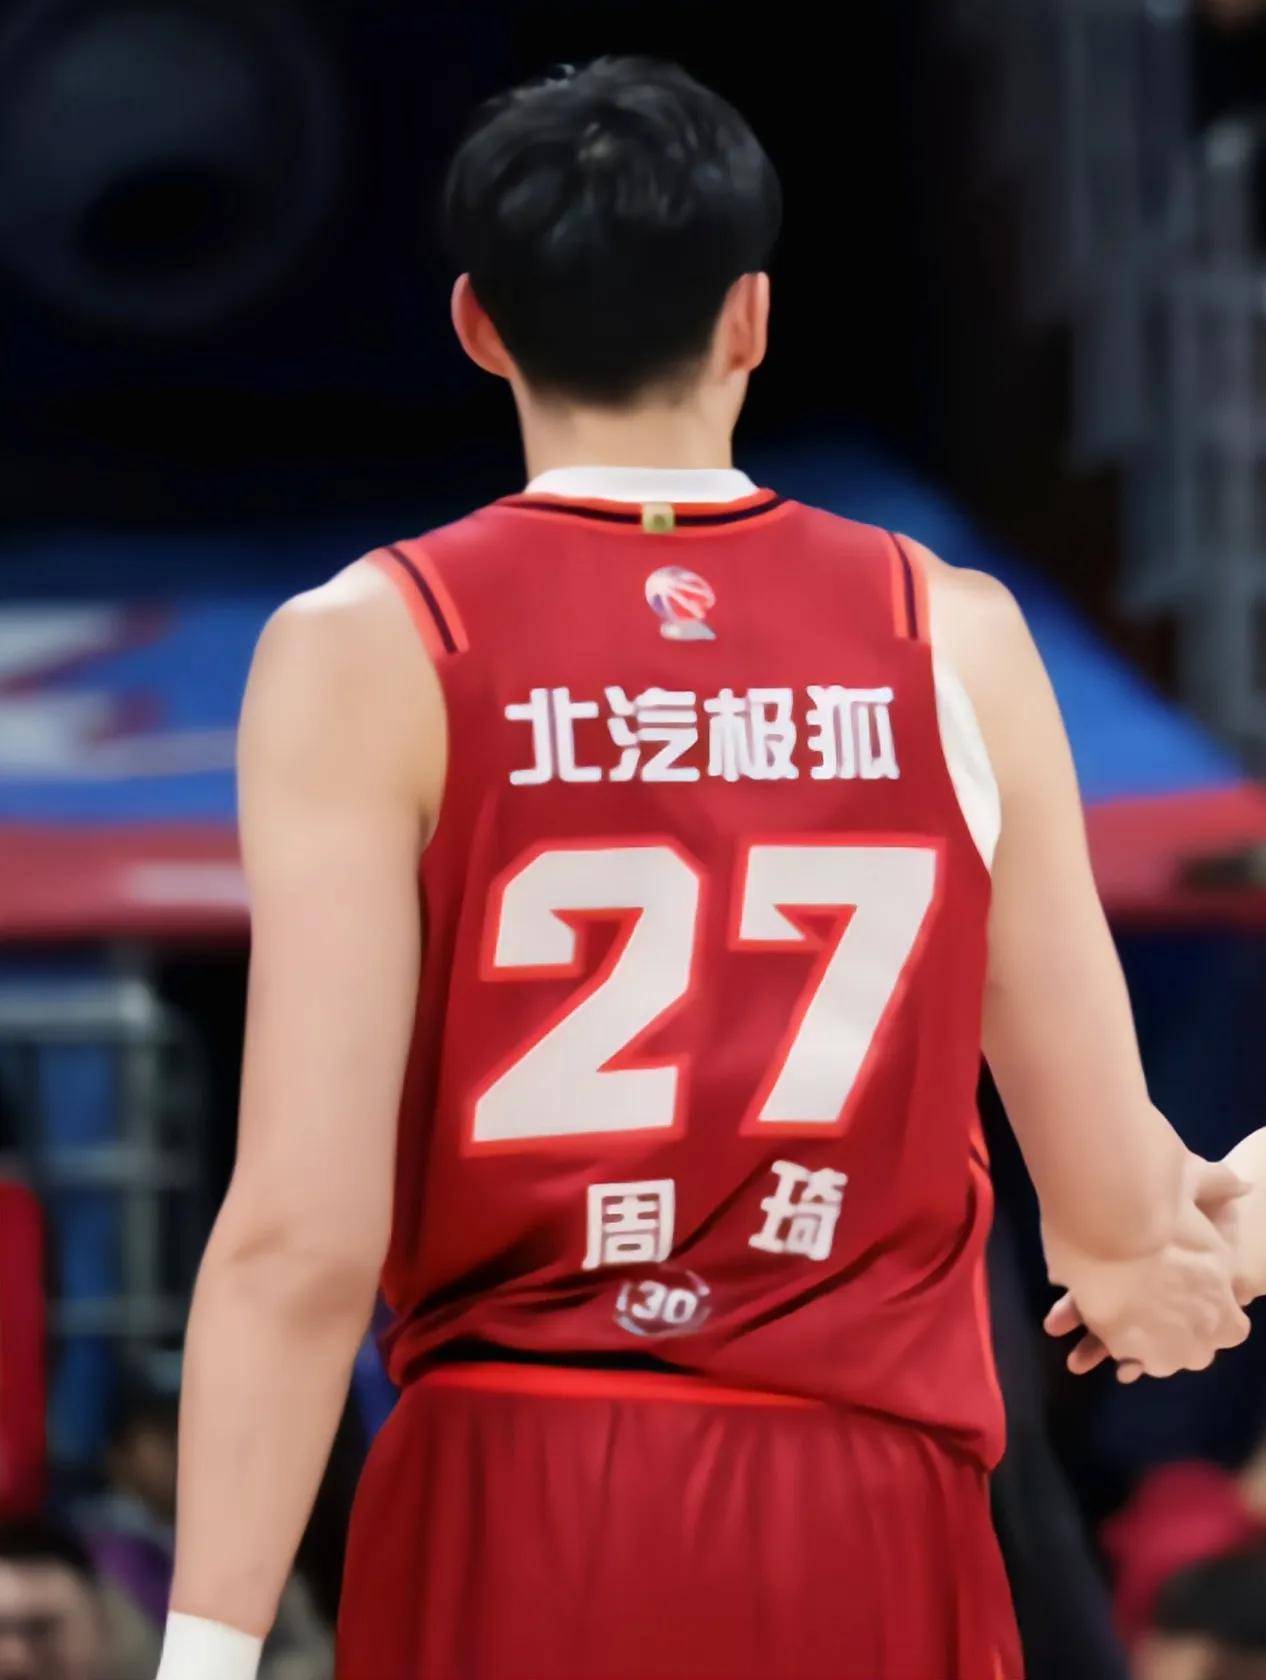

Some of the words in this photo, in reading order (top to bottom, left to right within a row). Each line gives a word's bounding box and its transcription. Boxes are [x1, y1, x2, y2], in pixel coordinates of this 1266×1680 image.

[504, 685, 900, 785] 北汽极狐
[466, 840, 942, 1150] 27
[630, 1280, 698, 1324] 30
